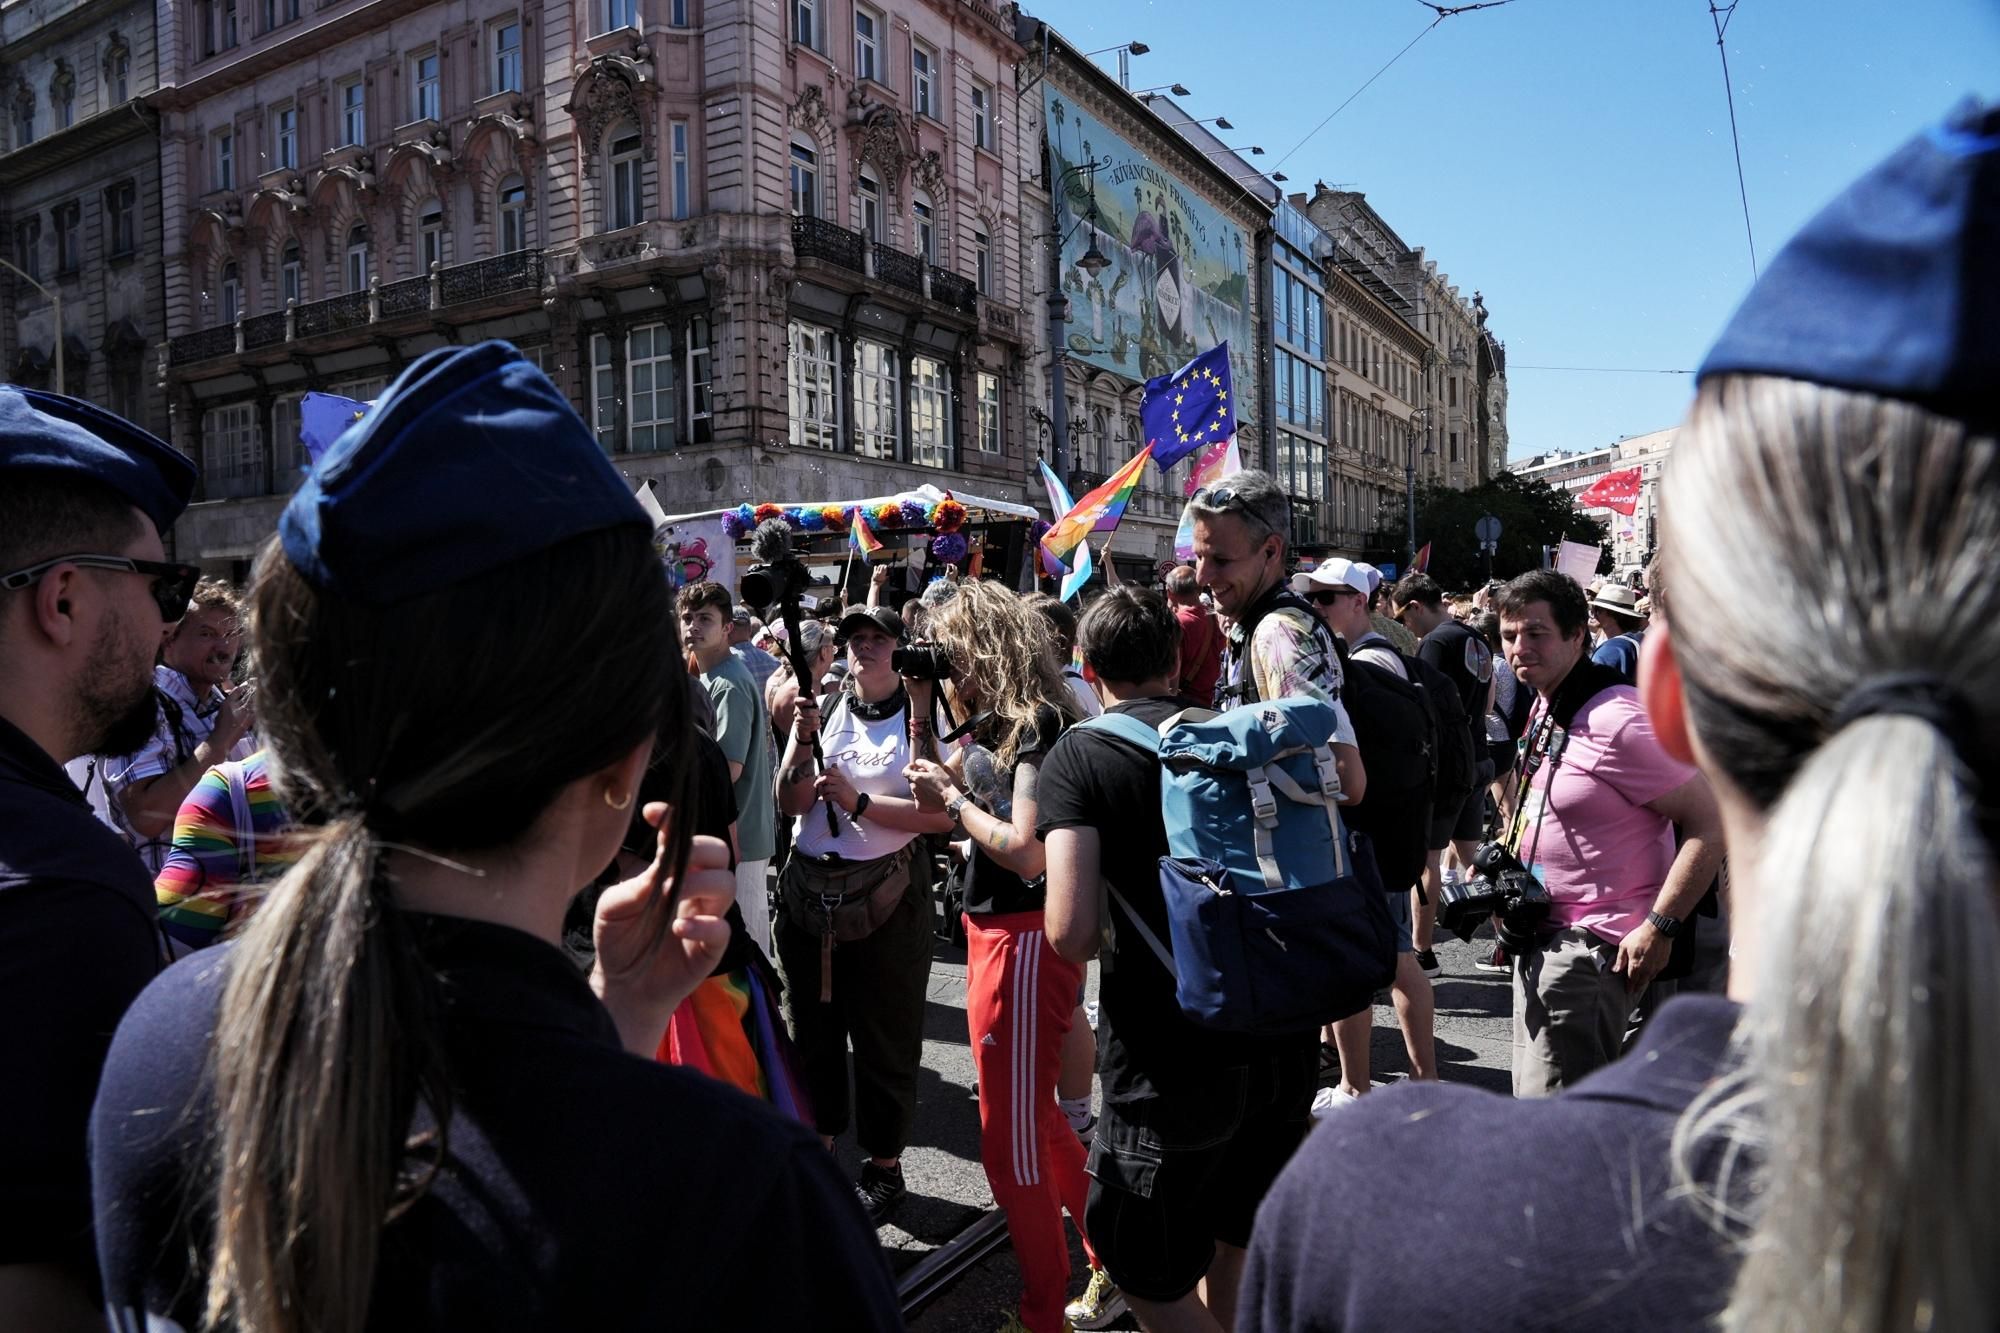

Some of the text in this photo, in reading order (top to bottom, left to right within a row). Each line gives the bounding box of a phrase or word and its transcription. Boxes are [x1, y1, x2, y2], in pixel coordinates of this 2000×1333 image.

[1113, 159, 1206, 242] KÍVÁNCSIAN FRISSÍTŐ
[820, 730, 897, 767] Coast
[1536, 728, 1549, 752] EOS
